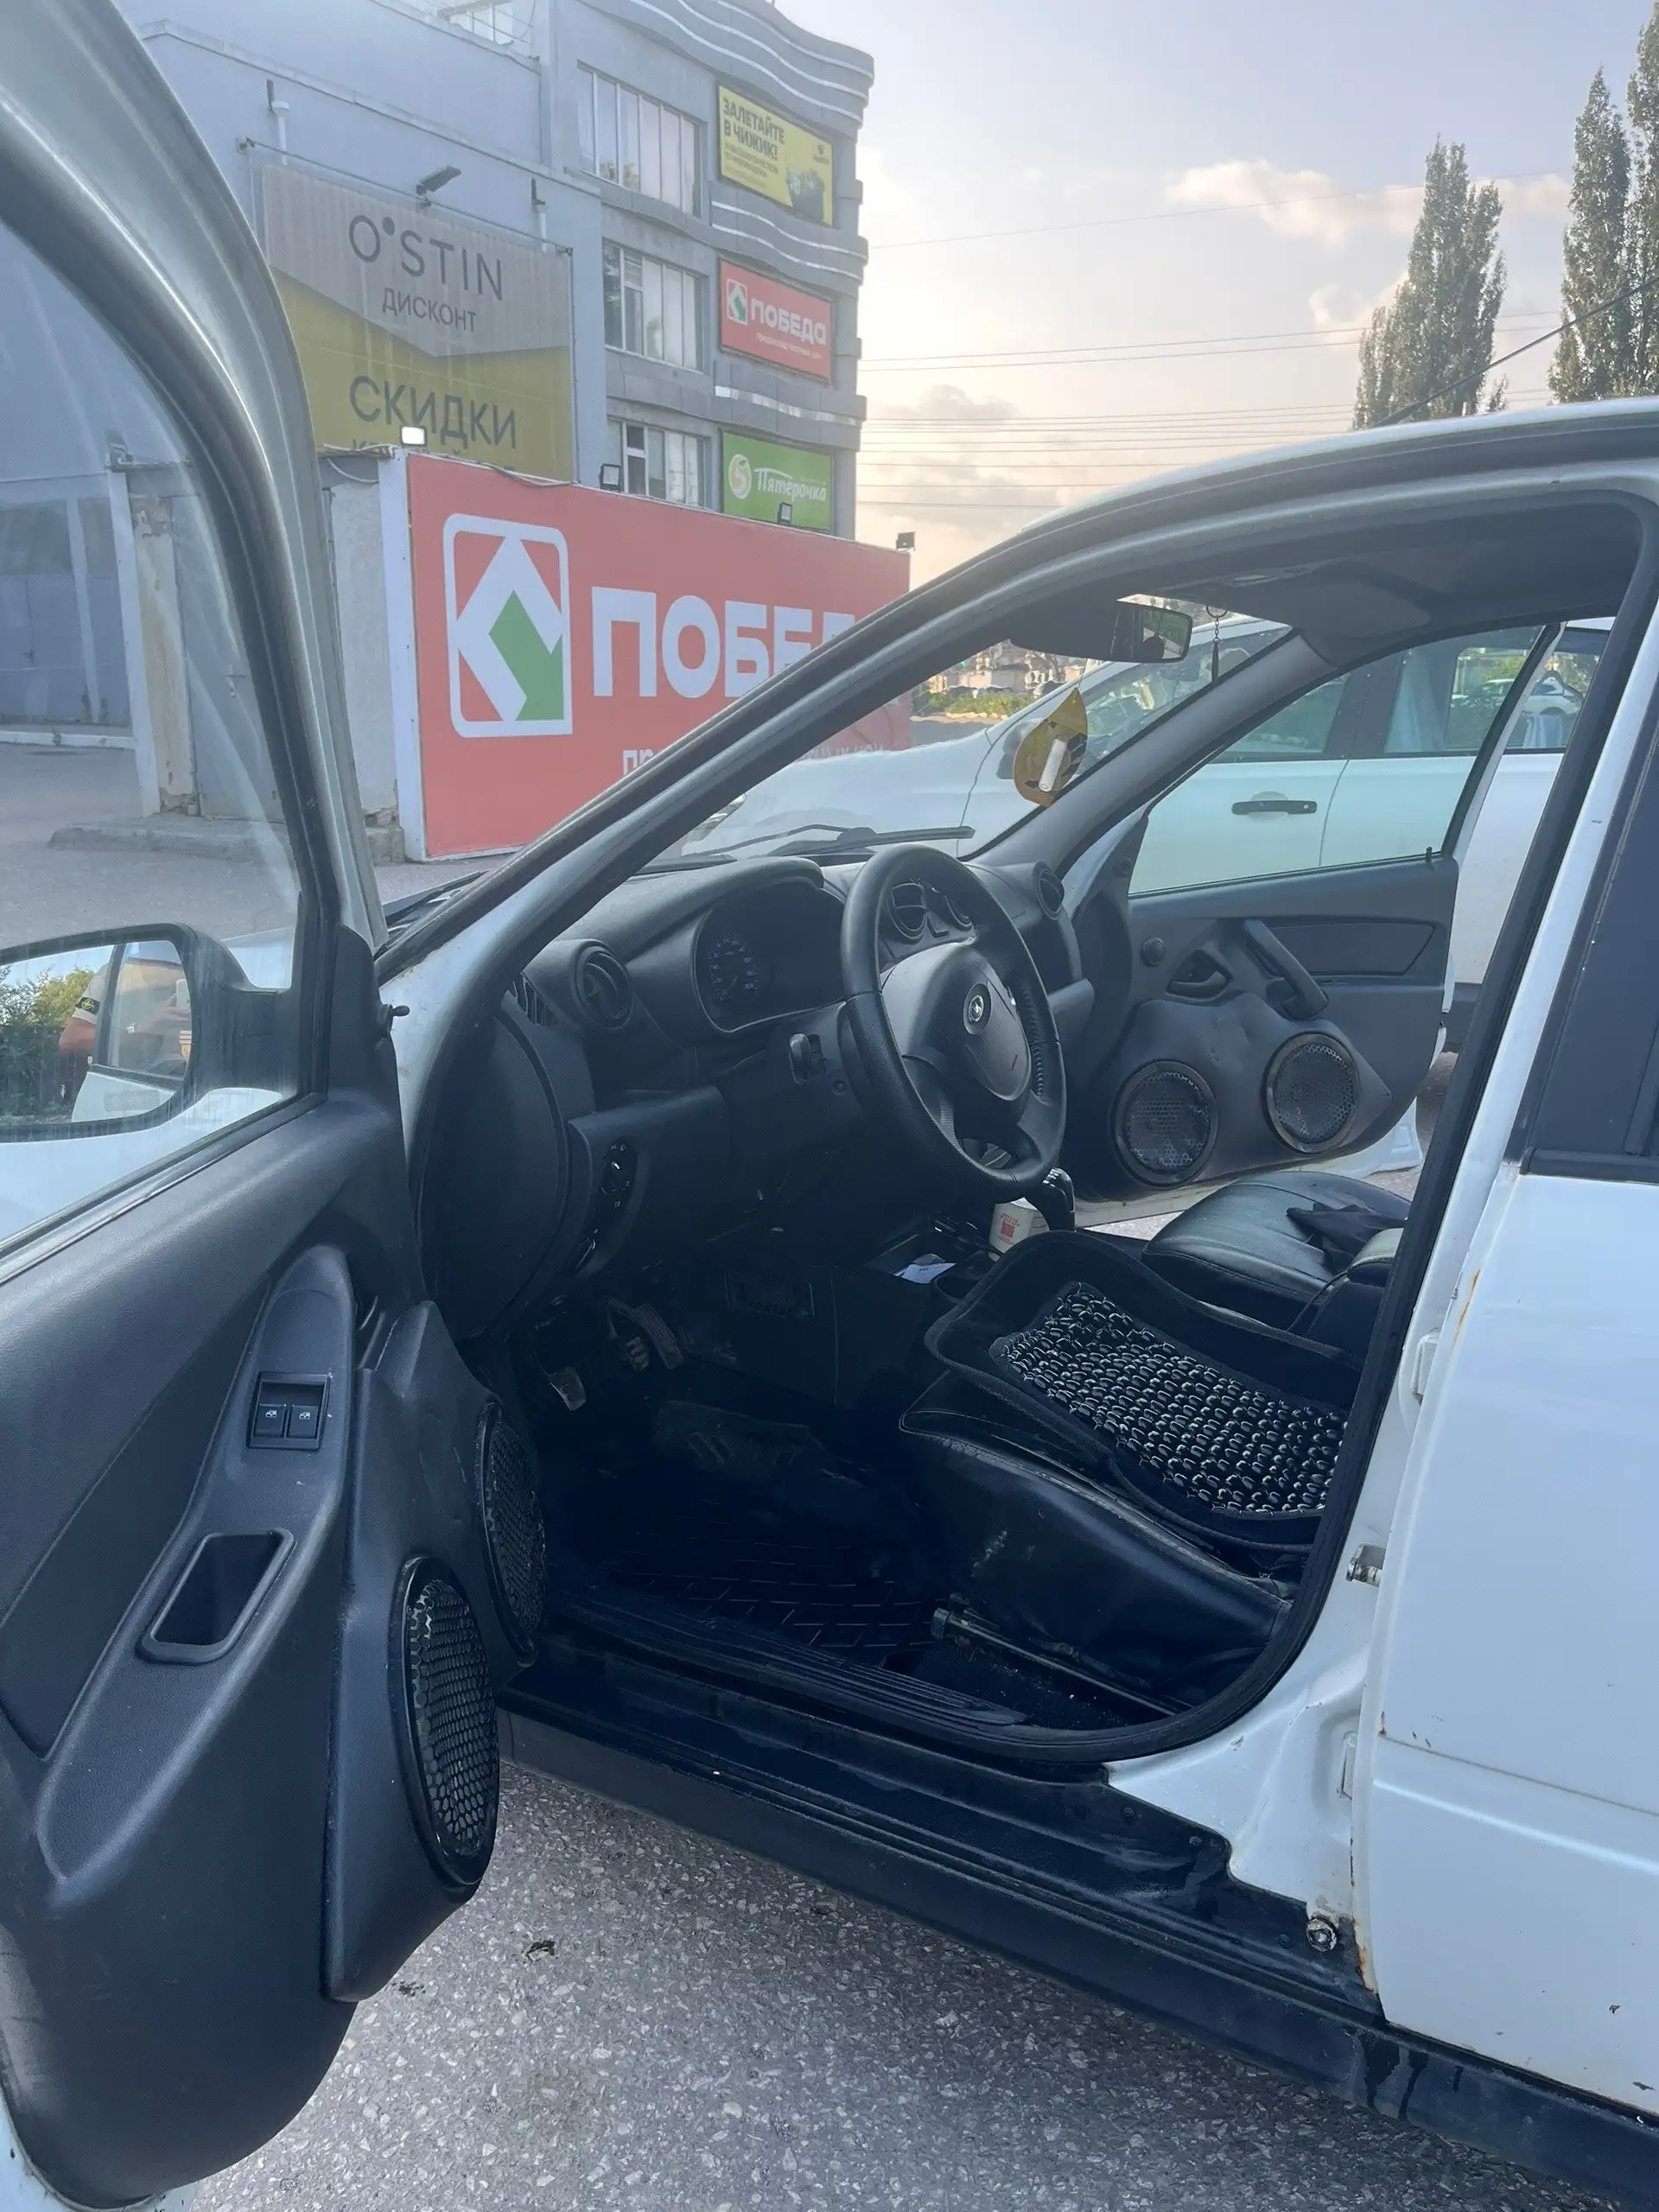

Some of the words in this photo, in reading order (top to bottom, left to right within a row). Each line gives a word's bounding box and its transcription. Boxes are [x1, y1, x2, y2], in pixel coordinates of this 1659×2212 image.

[723, 97, 785, 144] ЗАЛЕТАЙТЕ
[723, 118, 732, 138] В
[734, 122, 779, 162] ЧИЖИК!
[382, 287, 477, 334] ДИСКОНТ
[750, 297, 827, 346] ПОБЕДА
[349, 375, 517, 450] СКИДКИ
[754, 467, 826, 504] Пятерочка
